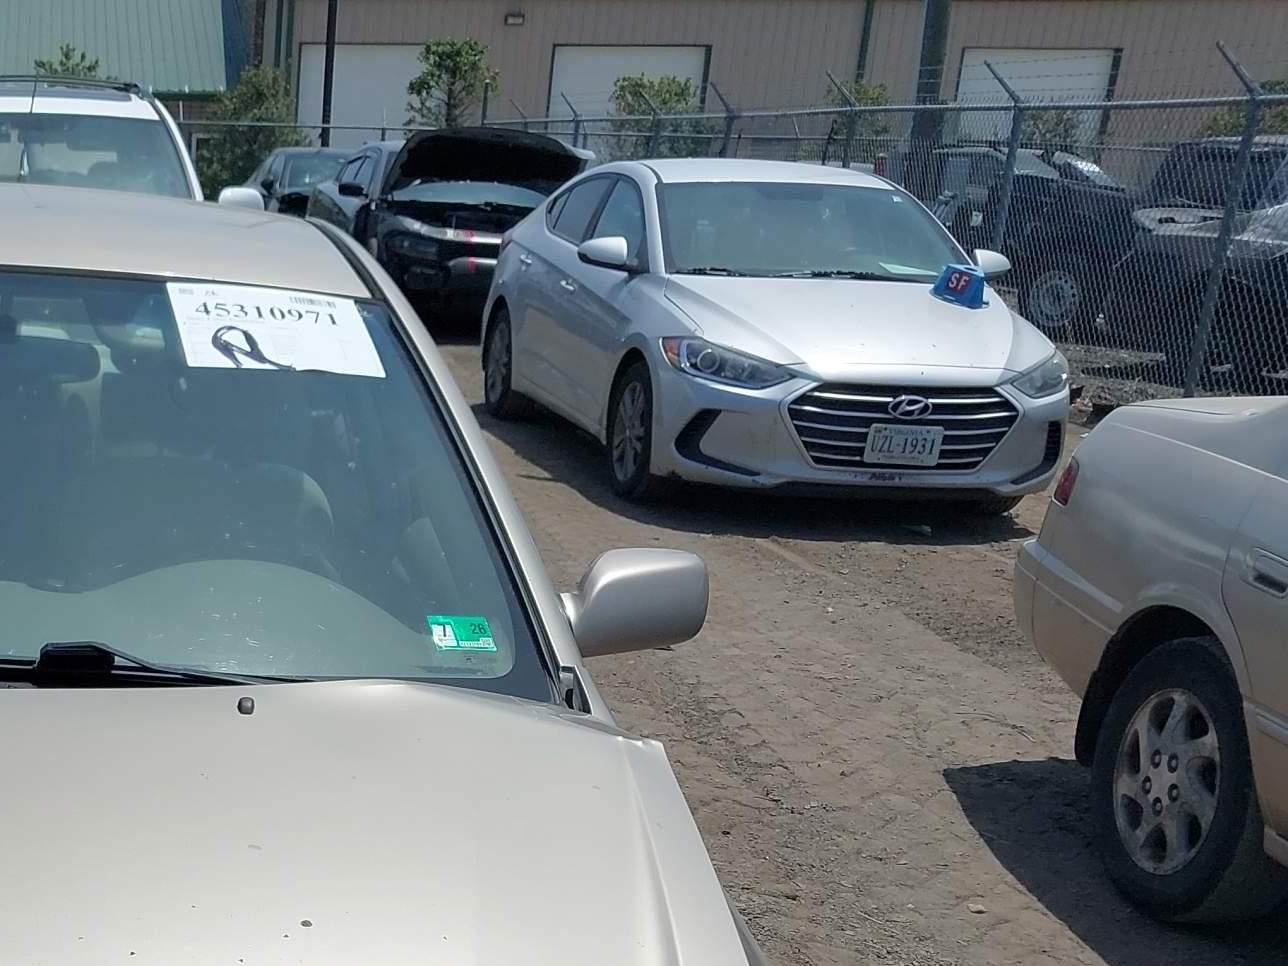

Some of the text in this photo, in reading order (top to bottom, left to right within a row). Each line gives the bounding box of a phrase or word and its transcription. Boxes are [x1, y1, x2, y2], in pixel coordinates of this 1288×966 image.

[948, 272, 970, 290] SF
[195, 301, 339, 326] 45310971
[871, 434, 937, 456] UZL-1931
